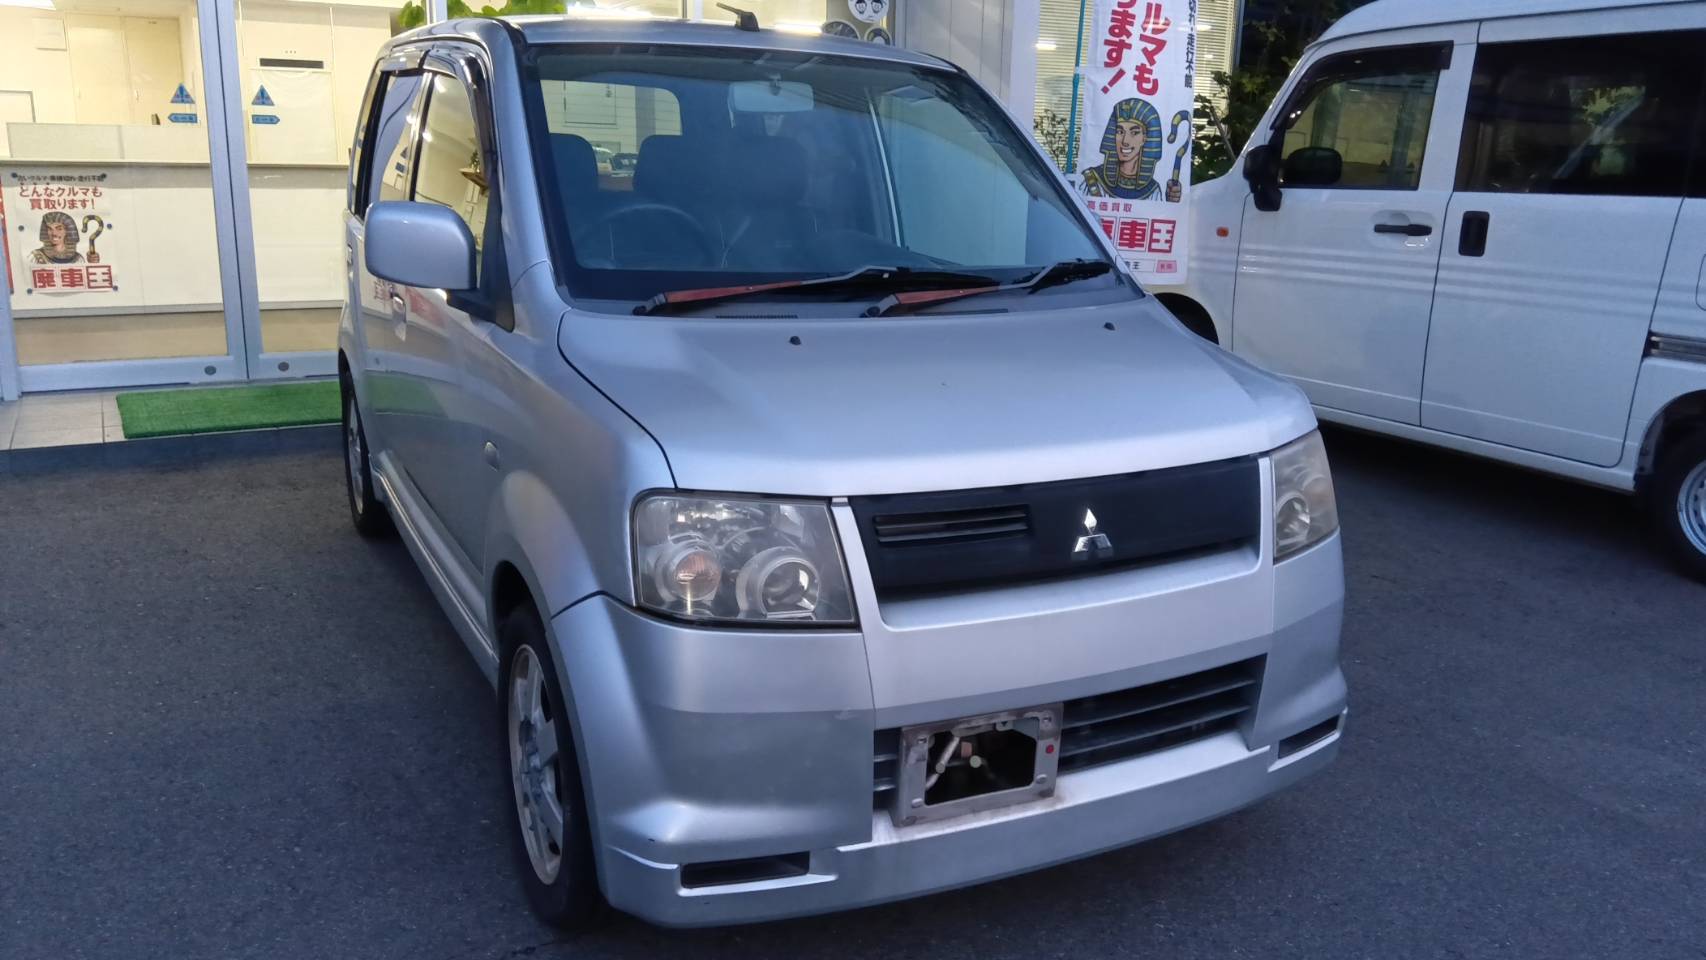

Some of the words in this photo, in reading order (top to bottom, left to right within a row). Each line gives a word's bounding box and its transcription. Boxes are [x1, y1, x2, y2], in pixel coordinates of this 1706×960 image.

[1132, 2, 1171, 96] ルマも
[19, 186, 103, 198] どんなクルマも
[30, 198, 96, 210] 買取ります!
[32, 265, 113, 289] 廃車王
